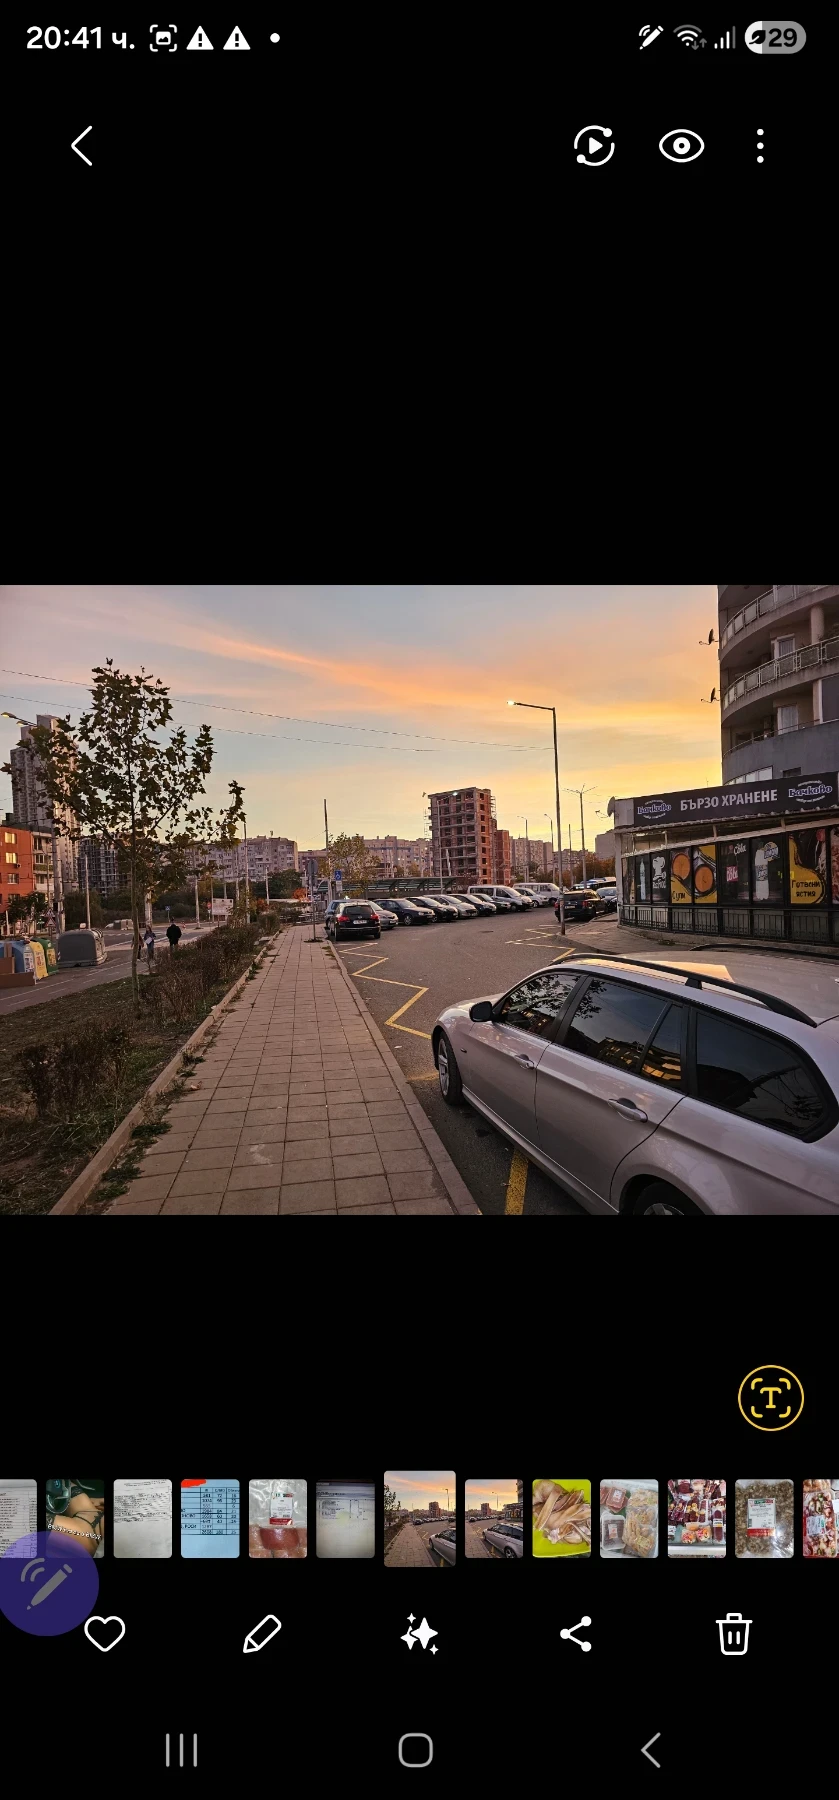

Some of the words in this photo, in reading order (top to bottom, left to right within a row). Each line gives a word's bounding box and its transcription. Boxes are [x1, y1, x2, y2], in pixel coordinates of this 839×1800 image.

[26, 25, 102, 50] 20:41
[111, 32, 136, 50] ч.
[768, 27, 798, 48] 29
[680, 796, 719, 811] БЪРЗО
[721, 789, 778, 807] ХРАНЕНЕ
[791, 880, 821, 888] Готвени
